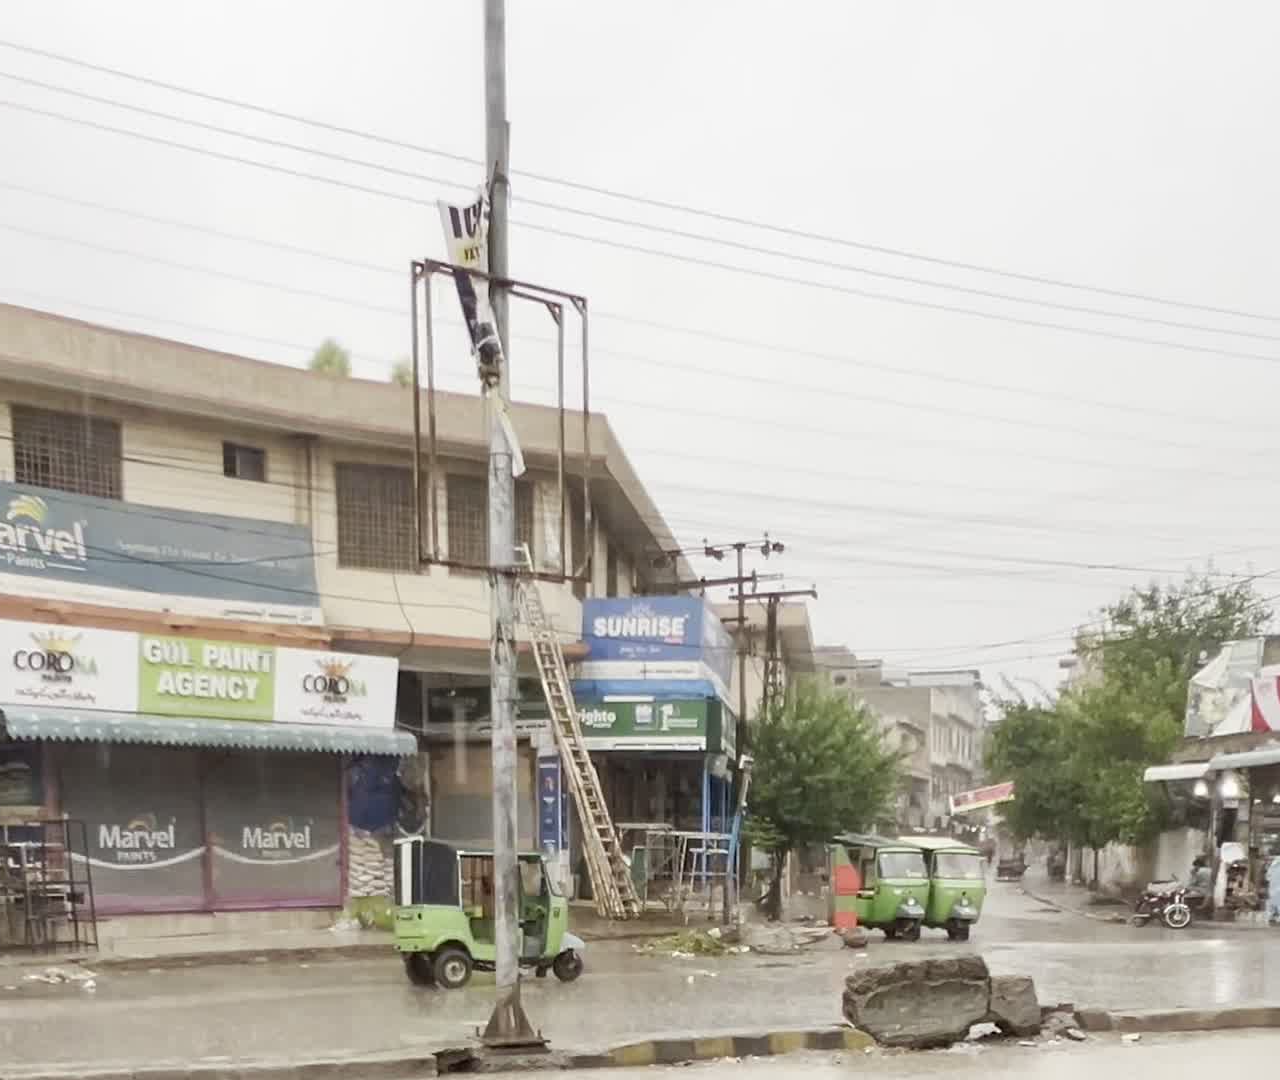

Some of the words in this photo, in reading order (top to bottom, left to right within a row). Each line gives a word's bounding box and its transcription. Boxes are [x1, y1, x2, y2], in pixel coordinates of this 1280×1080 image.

[593, 615, 686, 638] SUNRISE
[13, 649, 98, 675] CORONA
[143, 639, 193, 666] GUL
[203, 643, 273, 673] PAINT
[157, 671, 260, 700] AGENCY
[574, 707, 617, 727] righto
[99, 824, 175, 849] Marvel
[242, 825, 311, 849] Marvel
